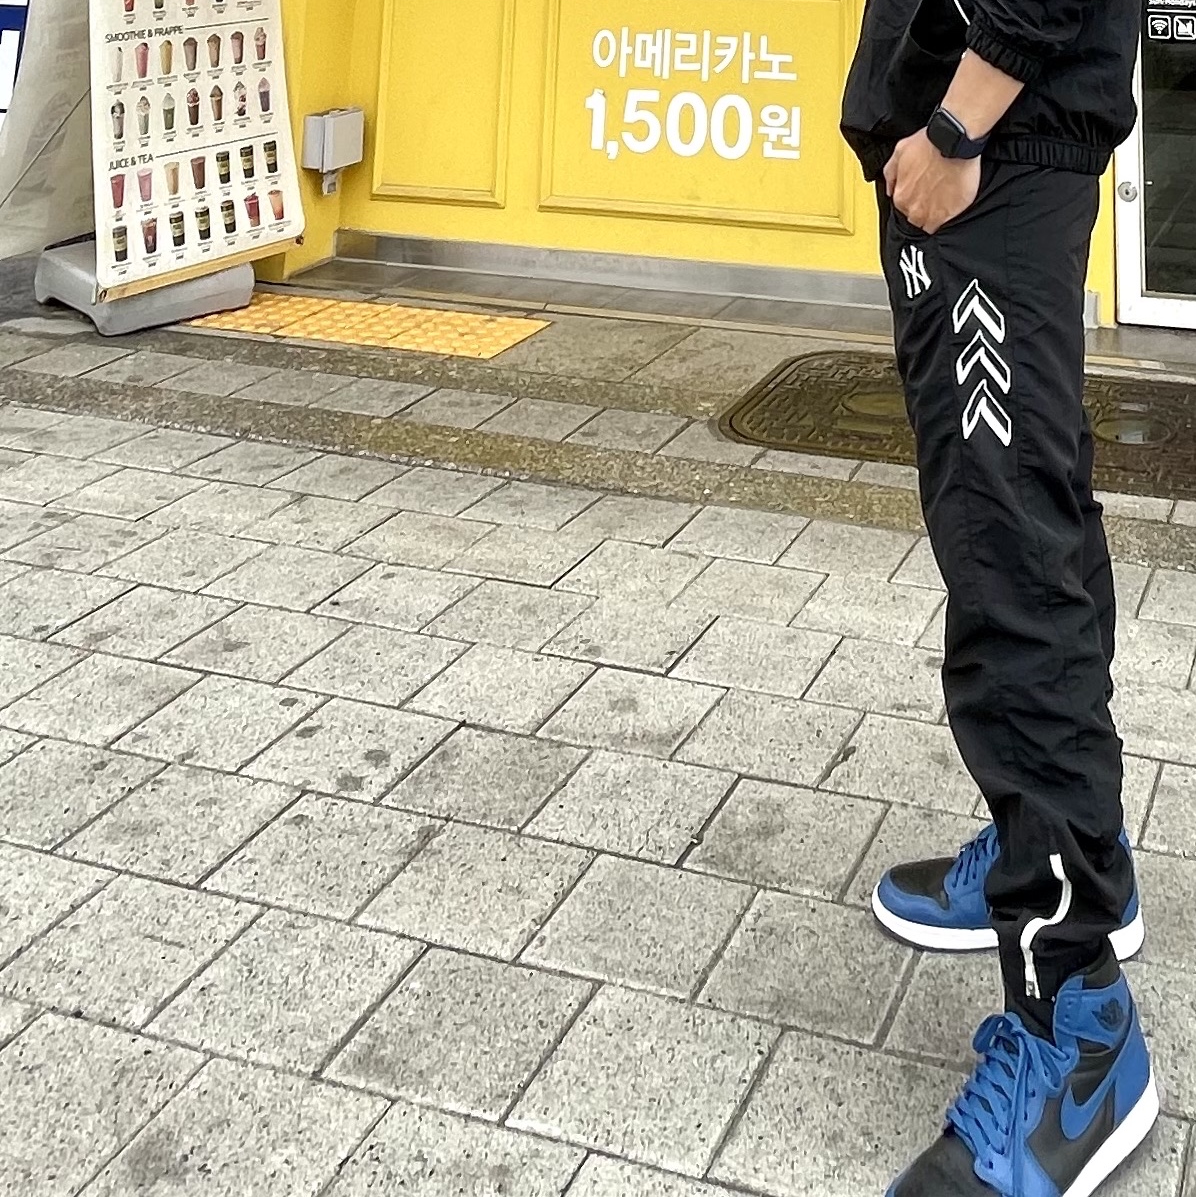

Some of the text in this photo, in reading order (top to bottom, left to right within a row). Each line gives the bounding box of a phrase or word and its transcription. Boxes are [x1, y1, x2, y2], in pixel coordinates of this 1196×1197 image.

[105, 30, 147, 44] SMOOTHIE
[153, 25, 184, 37] FRAPPE
[591, 25, 798, 84] 아메리카노
[584, 88, 802, 161] 1,500원
[108, 157, 131, 172] JUICE
[137, 153, 154, 164] TEA
[899, 244, 932, 299] NY
